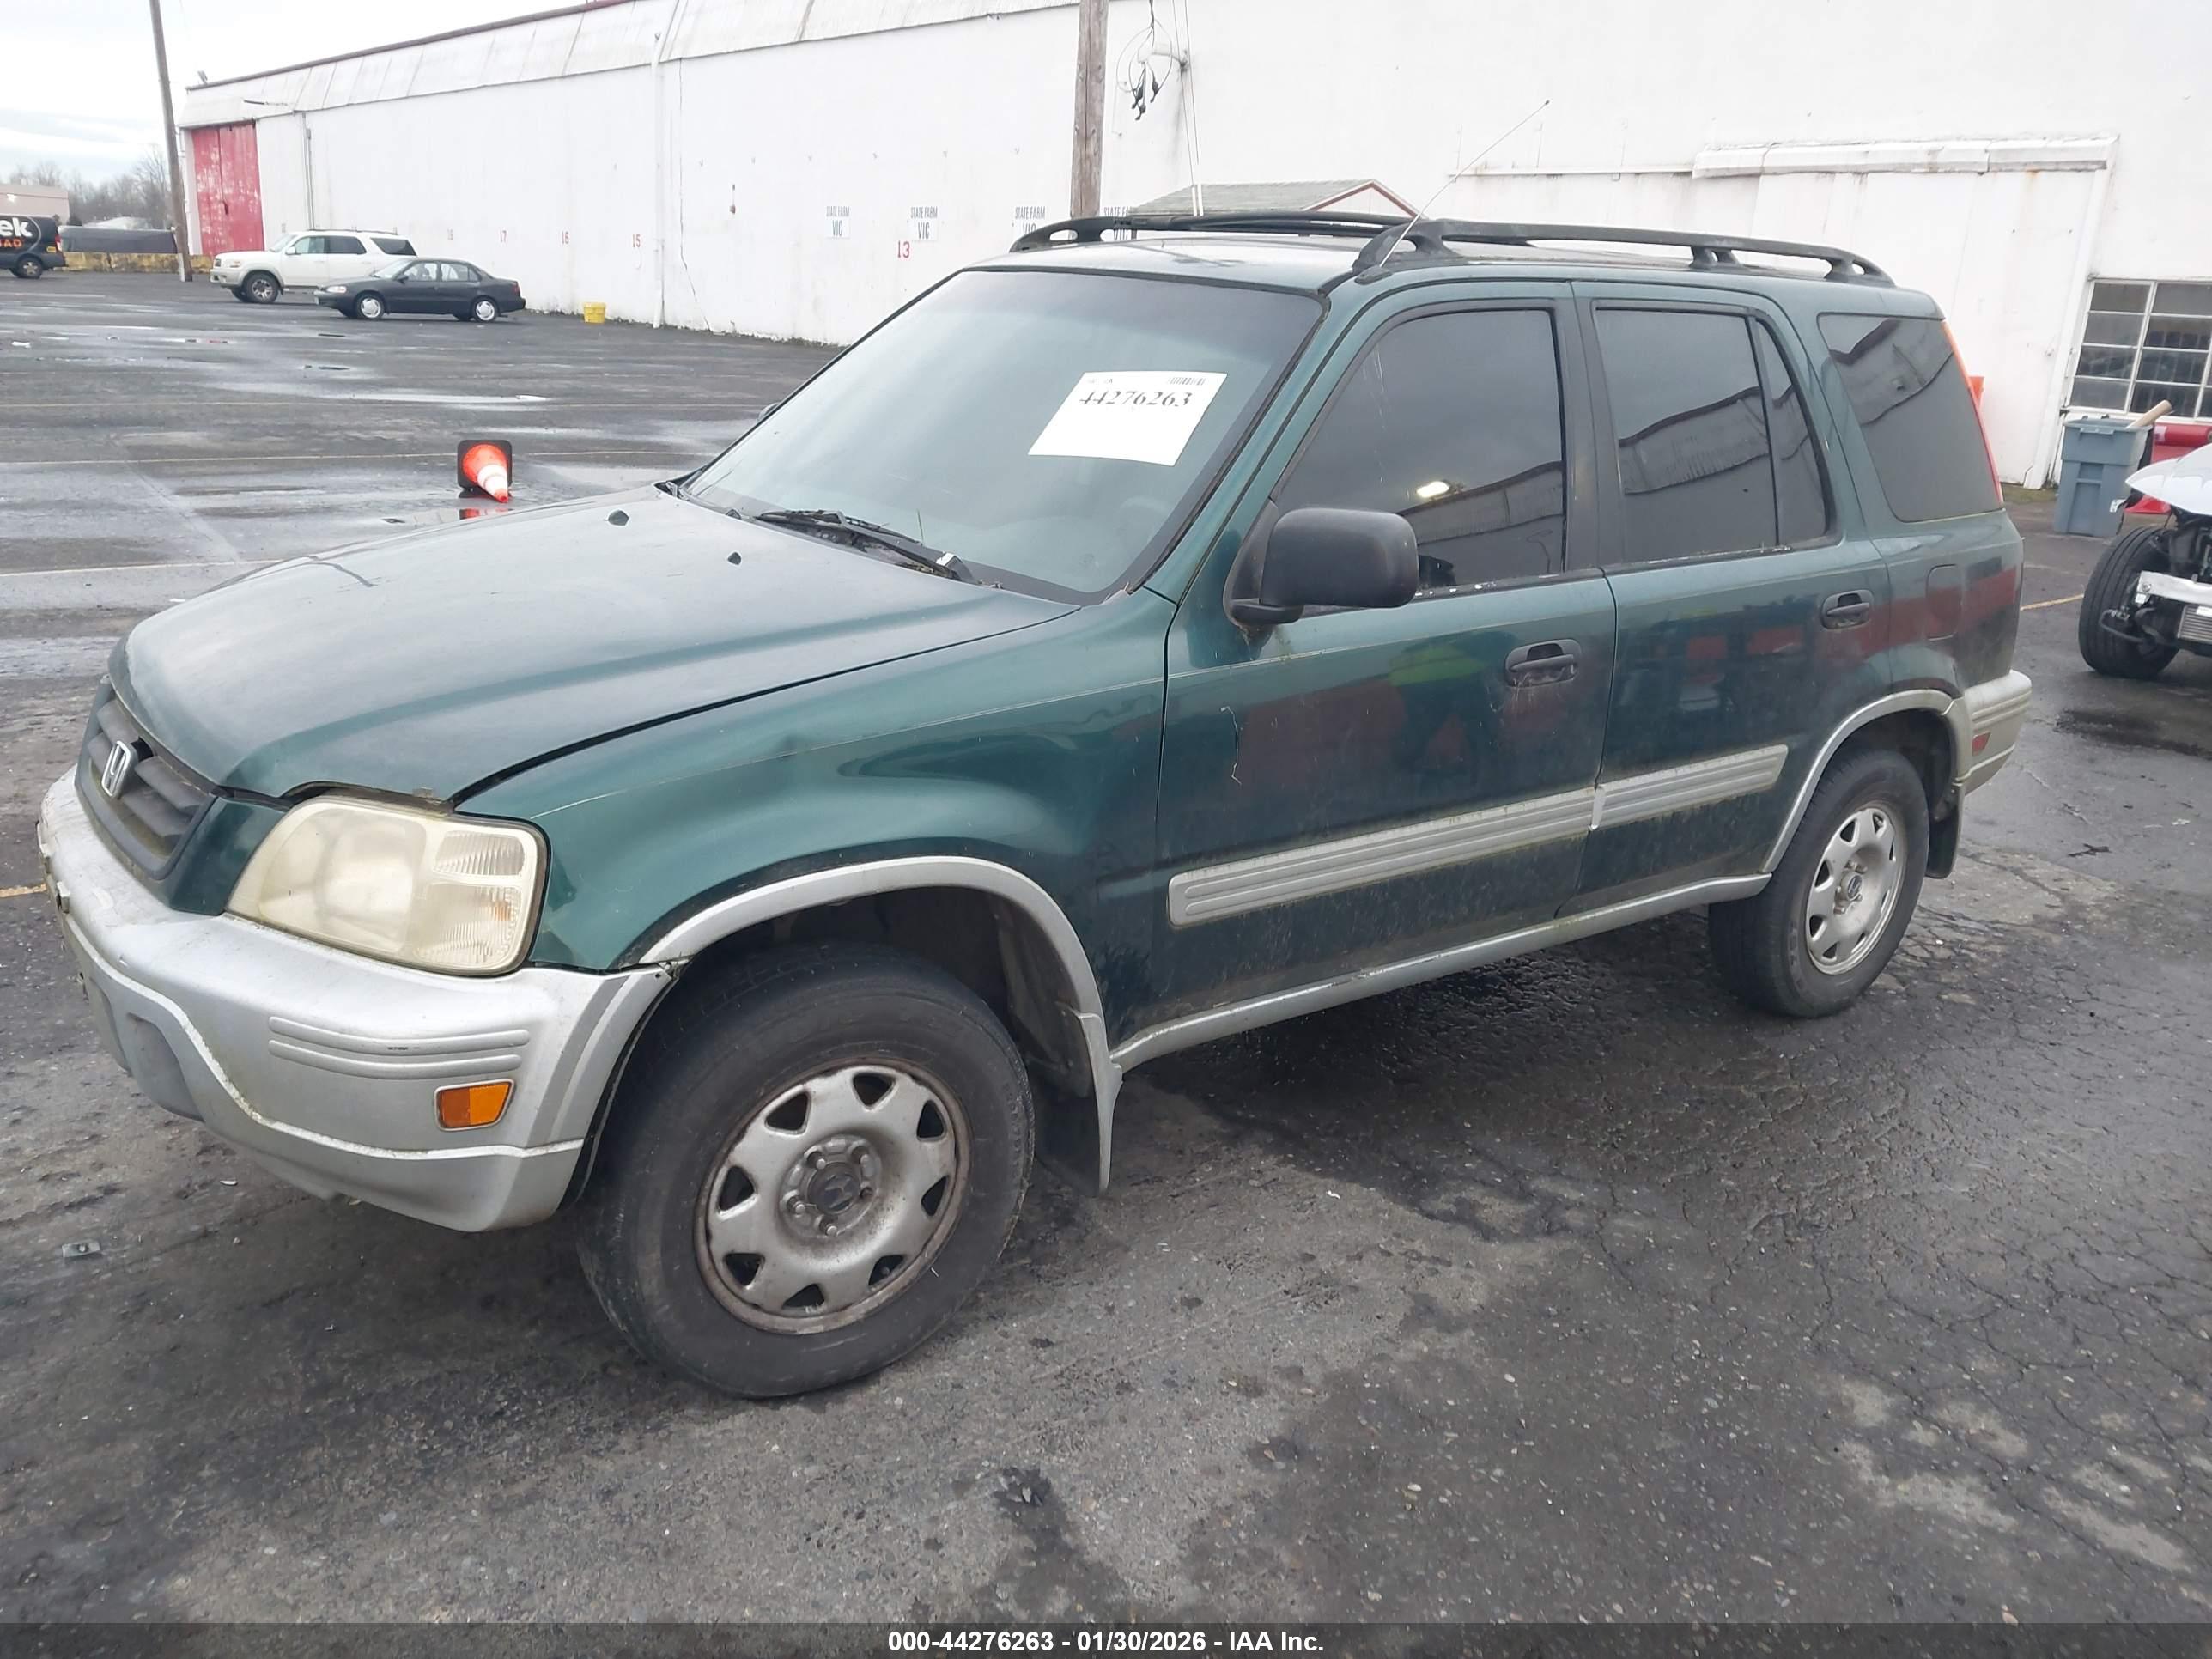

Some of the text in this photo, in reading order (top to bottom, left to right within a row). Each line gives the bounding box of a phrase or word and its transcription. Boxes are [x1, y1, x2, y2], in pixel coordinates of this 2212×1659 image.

[910, 206, 938, 219] STATE FARM
[1015, 206, 1045, 220] STATE FARM
[832, 220, 843, 236] VIC
[917, 222, 930, 240] VIC
[500, 230, 507, 243] 17
[632, 234, 641, 247] 15
[897, 240, 910, 258] 13
[1079, 391, 1194, 407] 44276263
